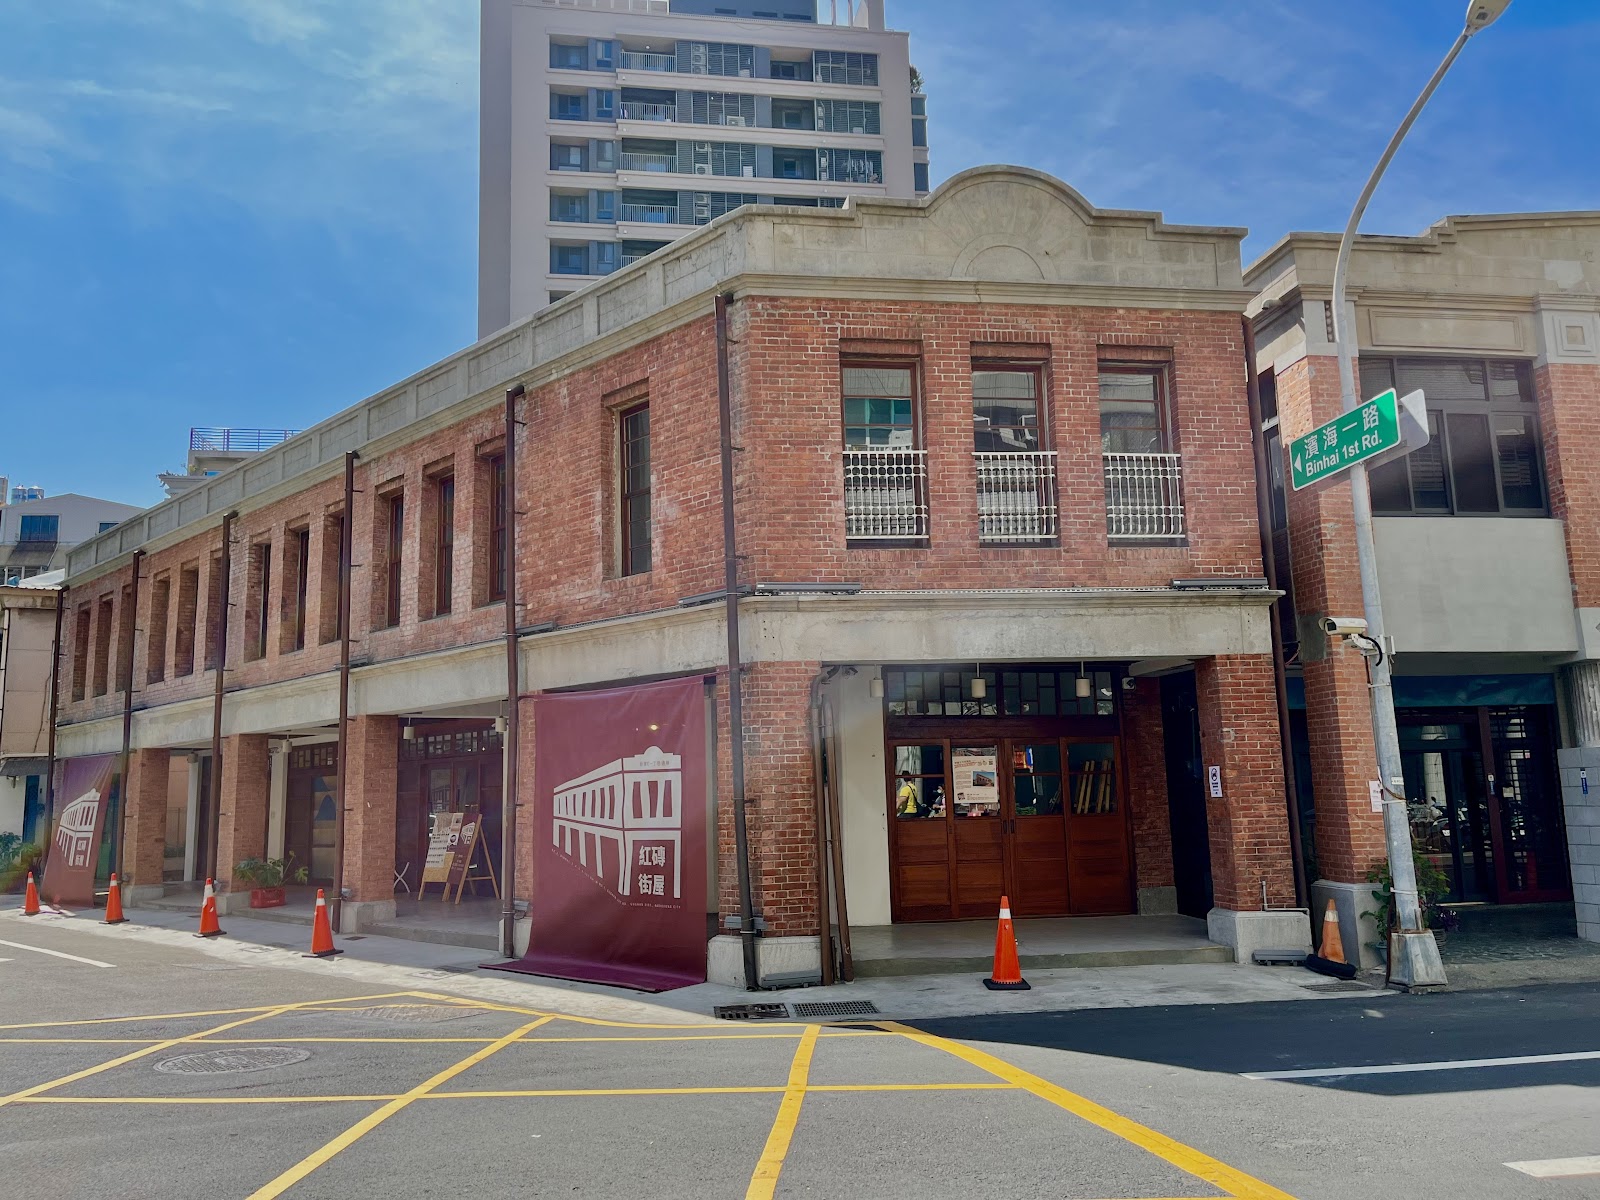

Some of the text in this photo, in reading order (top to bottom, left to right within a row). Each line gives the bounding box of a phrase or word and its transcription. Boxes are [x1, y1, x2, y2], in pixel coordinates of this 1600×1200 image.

[1304, 404, 1379, 460] 濱海一路
[1305, 430, 1383, 477] Binhai 1st Rd.
[639, 845, 666, 867] 紅磚
[638, 873, 665, 896] 街屋
